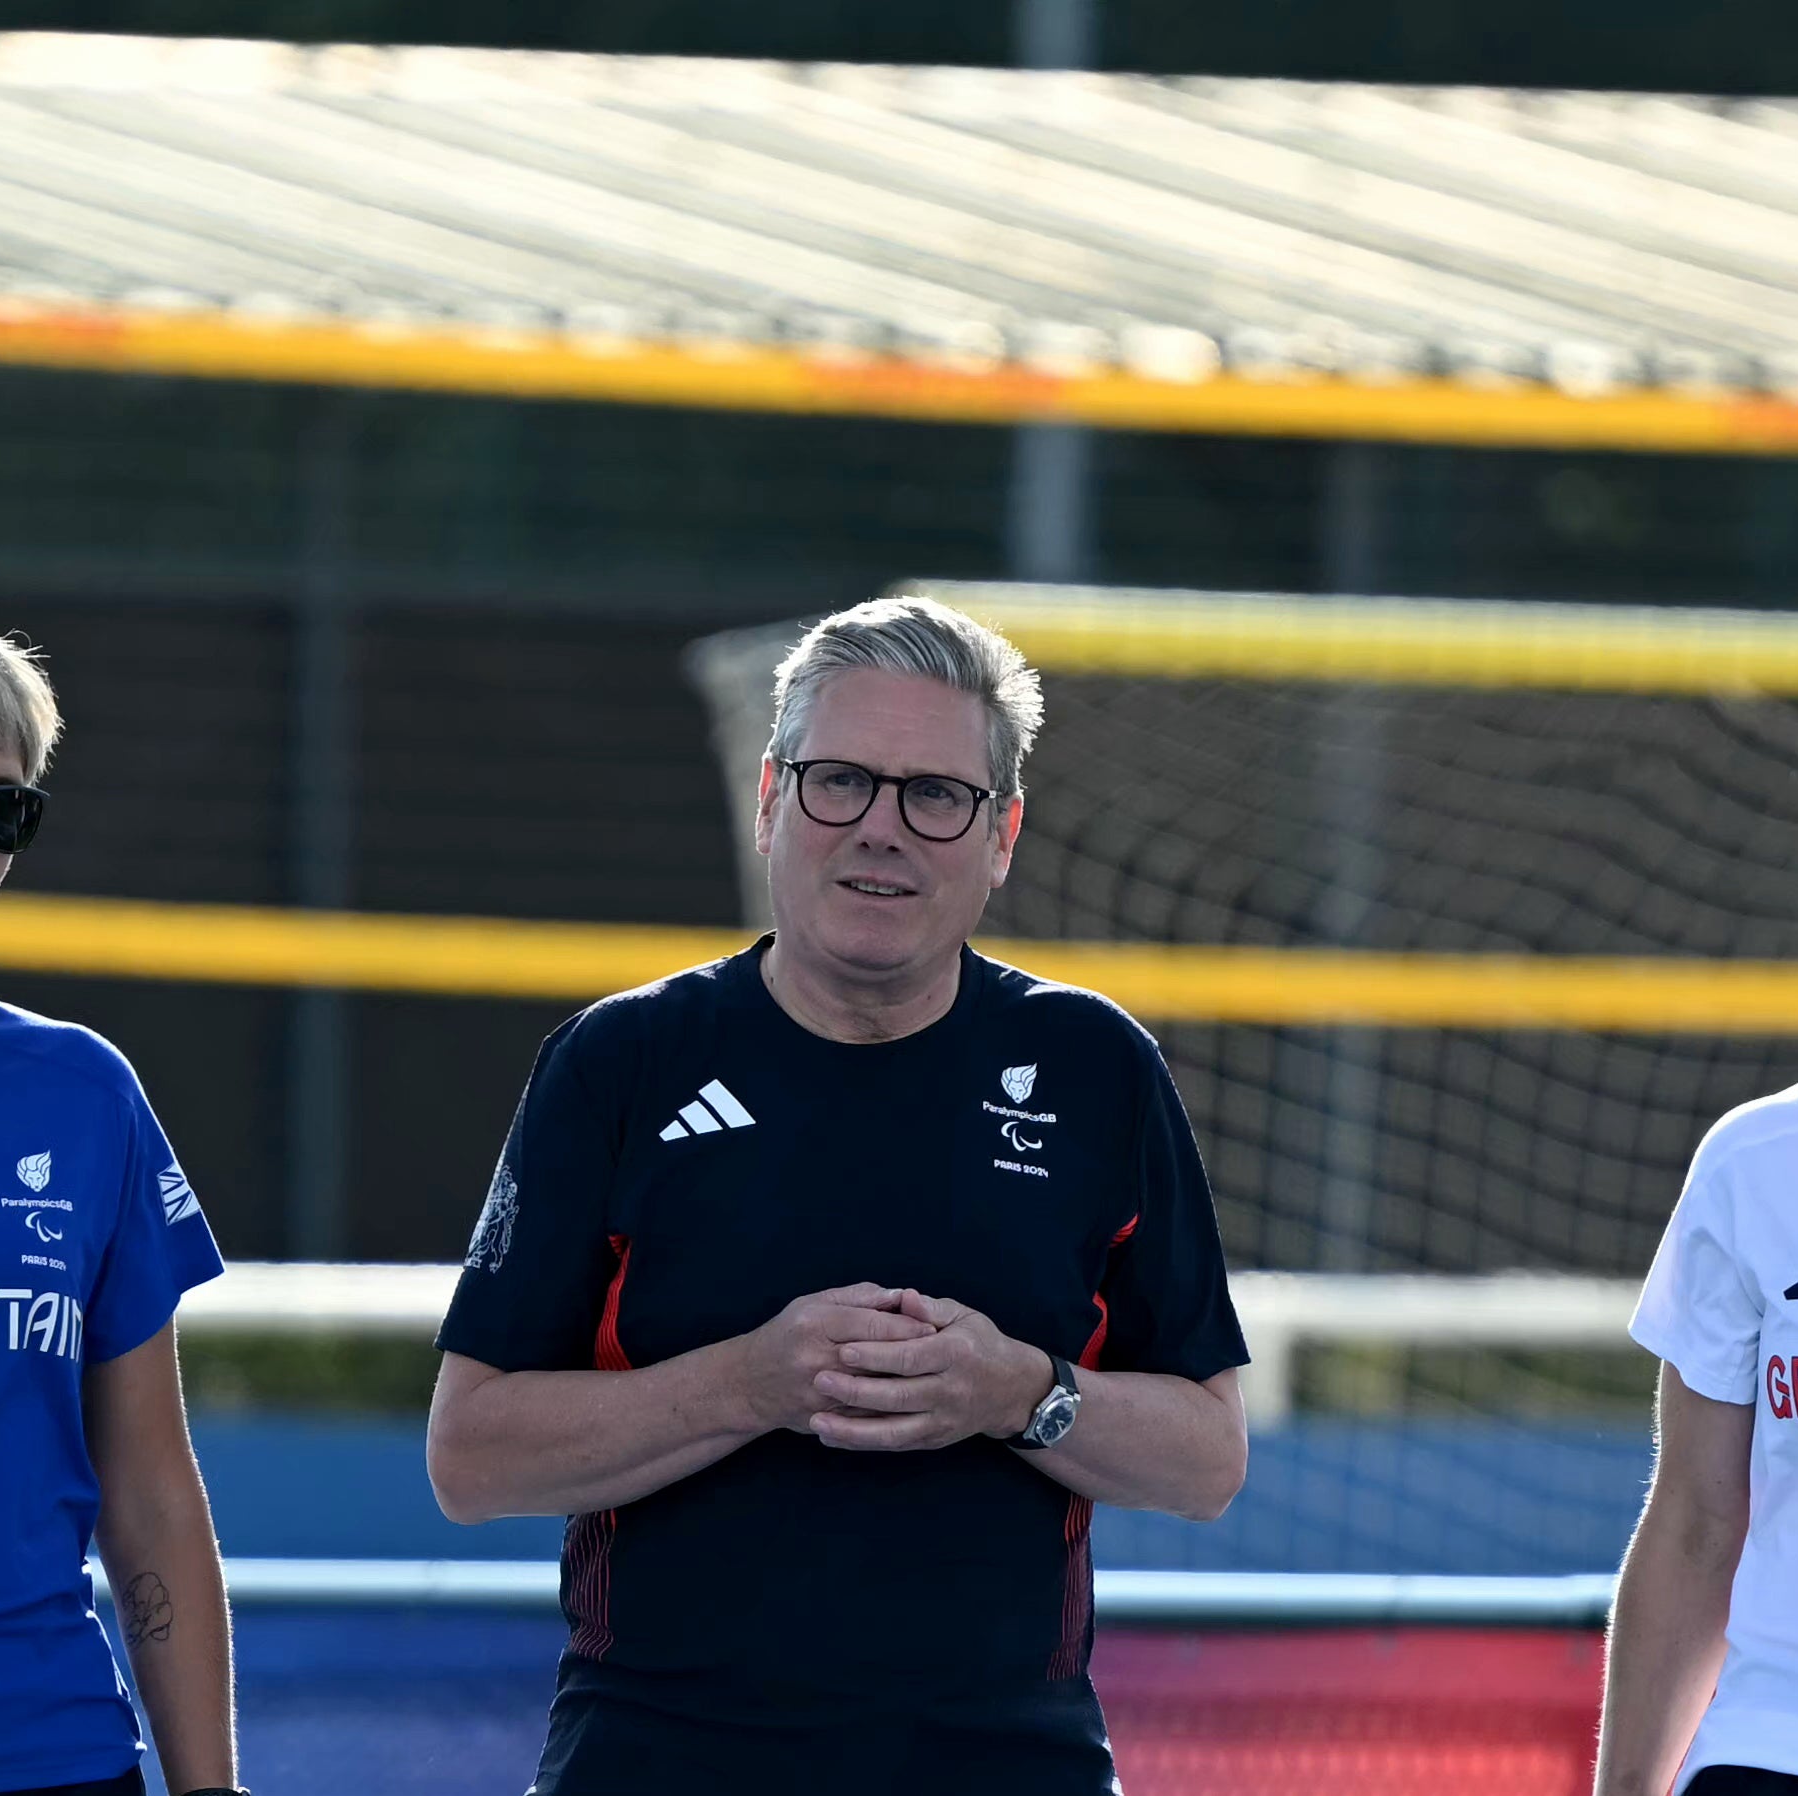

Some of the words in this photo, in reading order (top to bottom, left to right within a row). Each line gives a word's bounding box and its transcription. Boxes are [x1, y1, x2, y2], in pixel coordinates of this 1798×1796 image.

[983, 1100, 1057, 1123] ParalympicsGB
[994, 1159, 1022, 1172] PARIS
[1023, 1164, 1049, 1178] 2024
[1, 1197, 73, 1212] ParalympicsGB
[21, 1254, 48, 1266] PARIS
